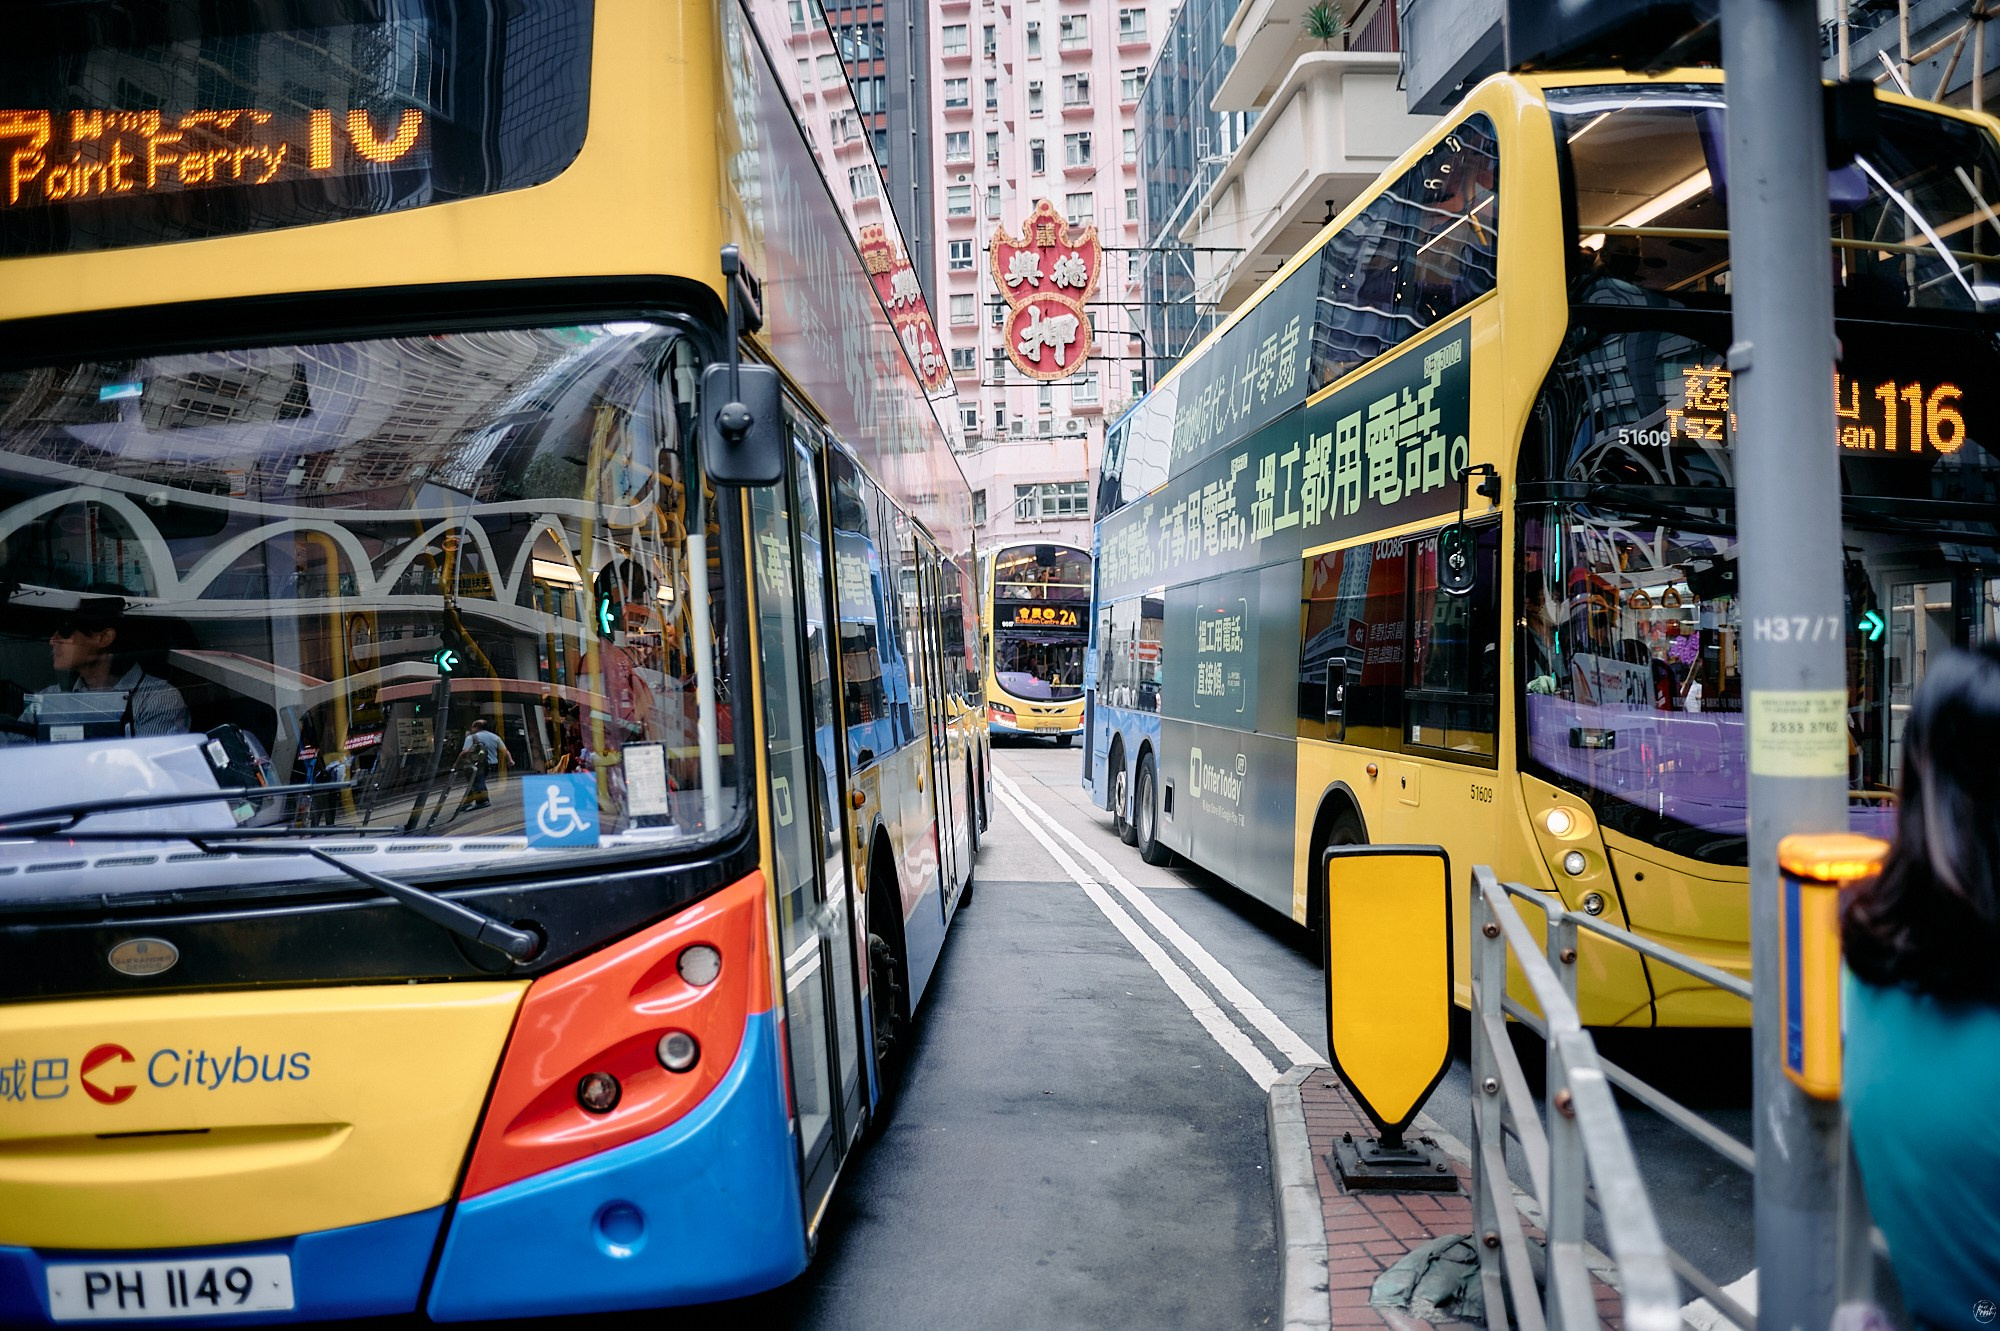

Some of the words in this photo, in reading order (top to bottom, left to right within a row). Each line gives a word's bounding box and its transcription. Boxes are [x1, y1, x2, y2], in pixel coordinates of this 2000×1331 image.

[10, 137, 135, 206] Point
[146, 131, 288, 189] Ferry
[1017, 305, 1080, 368] 押
[1618, 429, 1671, 447] 51609
[1875, 380, 1967, 455] 116
[1059, 609, 1077, 626] 2A
[1752, 616, 1840, 642] H37/7
[1202, 764, 1242, 807] OfferToday
[1471, 784, 1493, 804] 51609
[0, 1057, 70, 1102] 城巴
[147, 1045, 312, 1091] Citybus
[84, 1270, 147, 1310] PH
[166, 1266, 254, 1309] 1149
